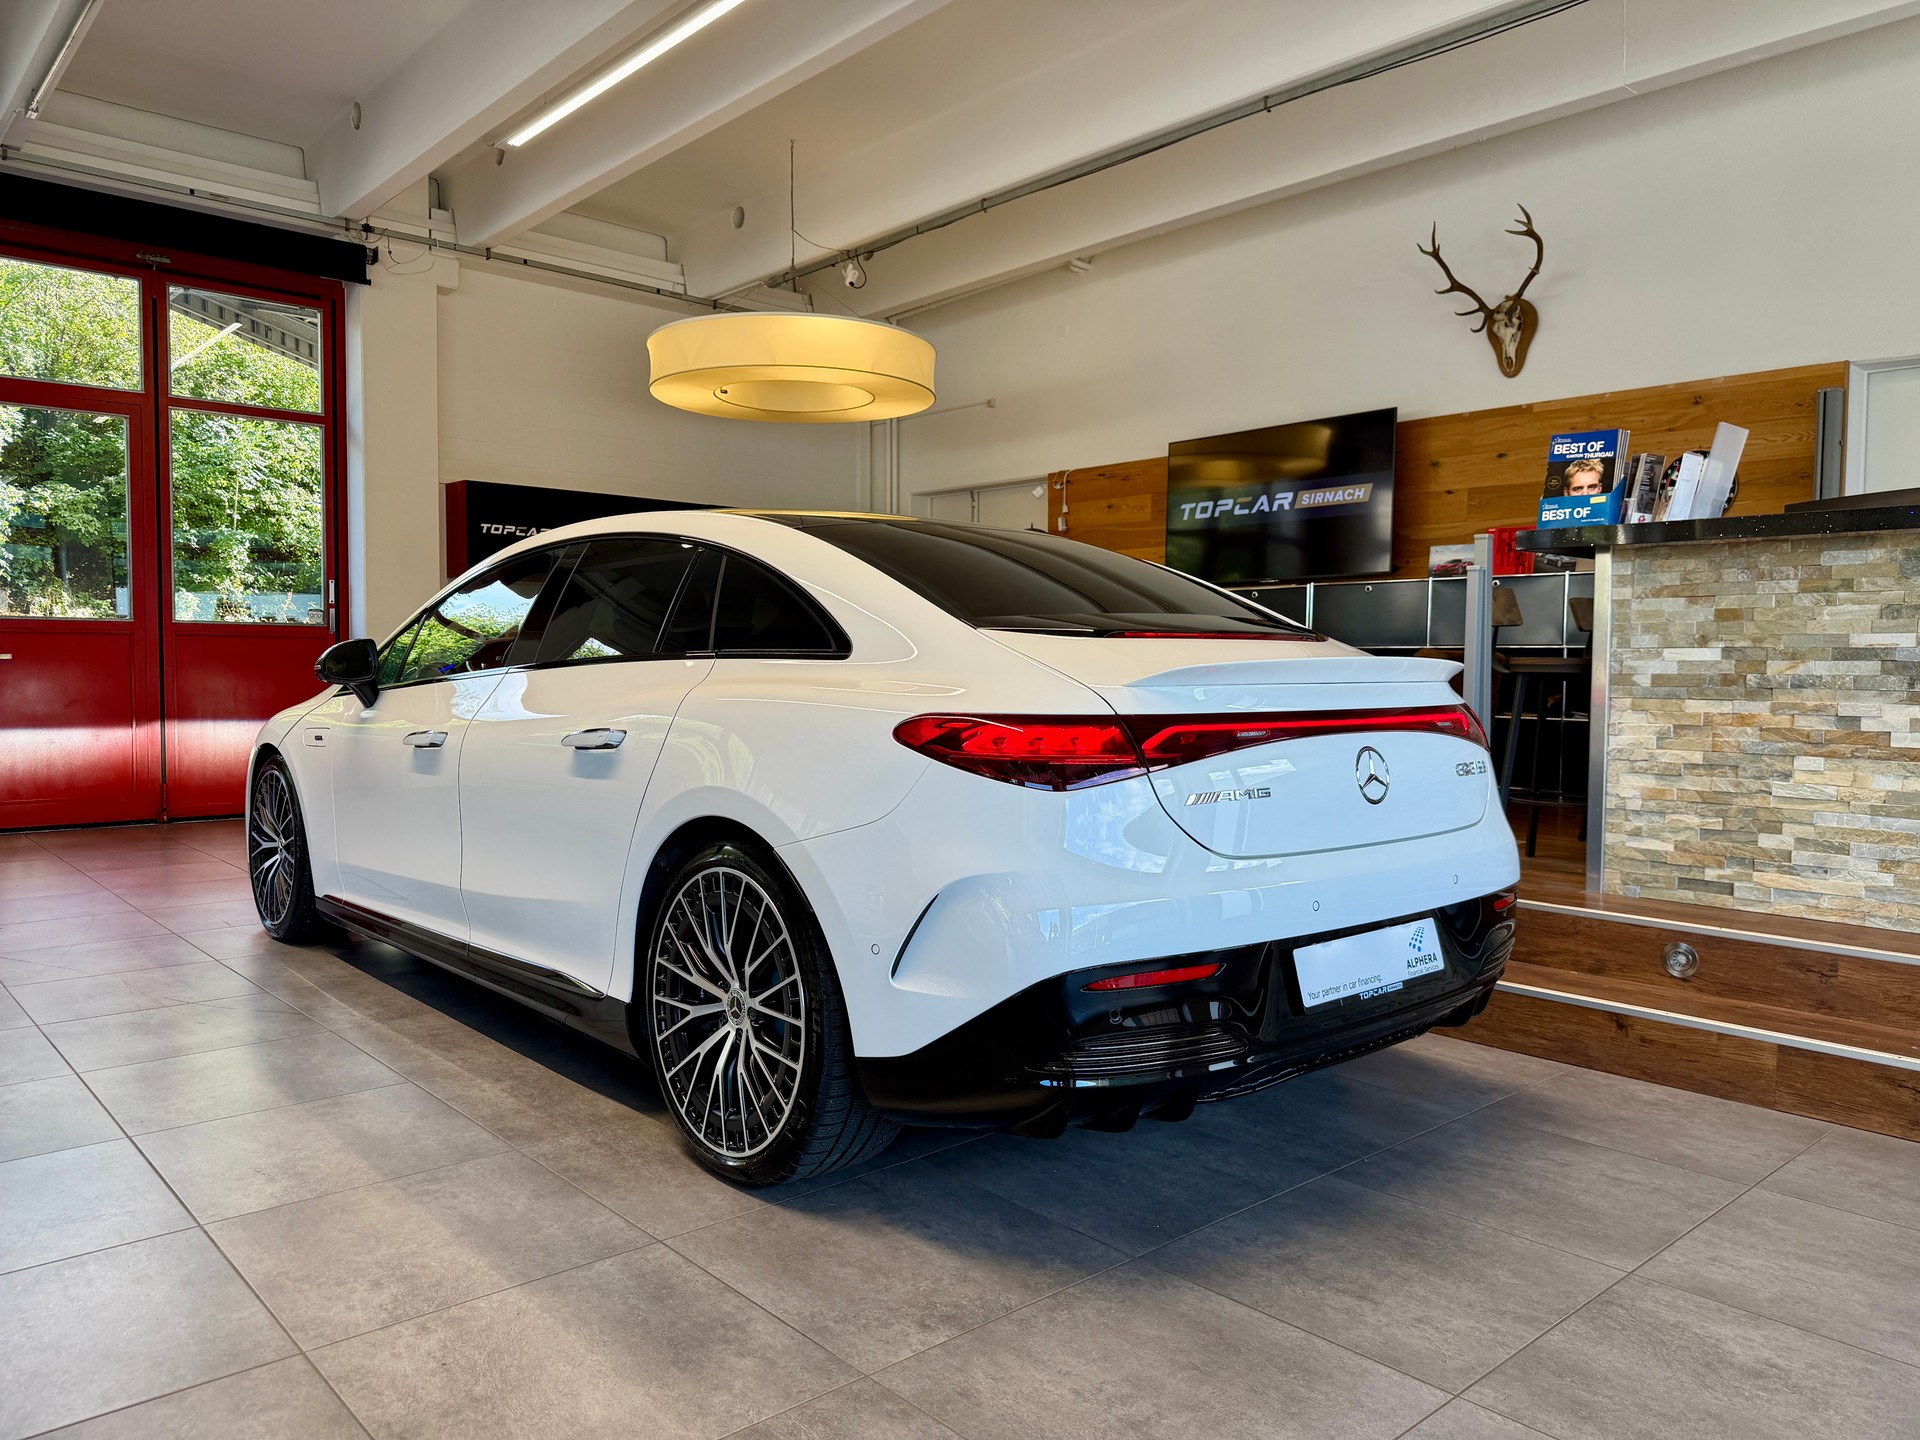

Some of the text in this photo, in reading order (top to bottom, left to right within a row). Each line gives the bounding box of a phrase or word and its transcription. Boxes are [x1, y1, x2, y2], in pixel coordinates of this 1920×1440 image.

[1554, 441, 1605, 454] BEST OF
[1584, 451, 1614, 459] THURGAU
[1180, 488, 1365, 521] TOPCAR SIRNACH
[1541, 506, 1592, 521] BEST OF
[1407, 953, 1438, 969] ALPHERA
[1407, 964, 1440, 977] Financial Services
[1307, 974, 1383, 1000] Your partner in car financing.
[1359, 987, 1388, 1000] TOPCAR
